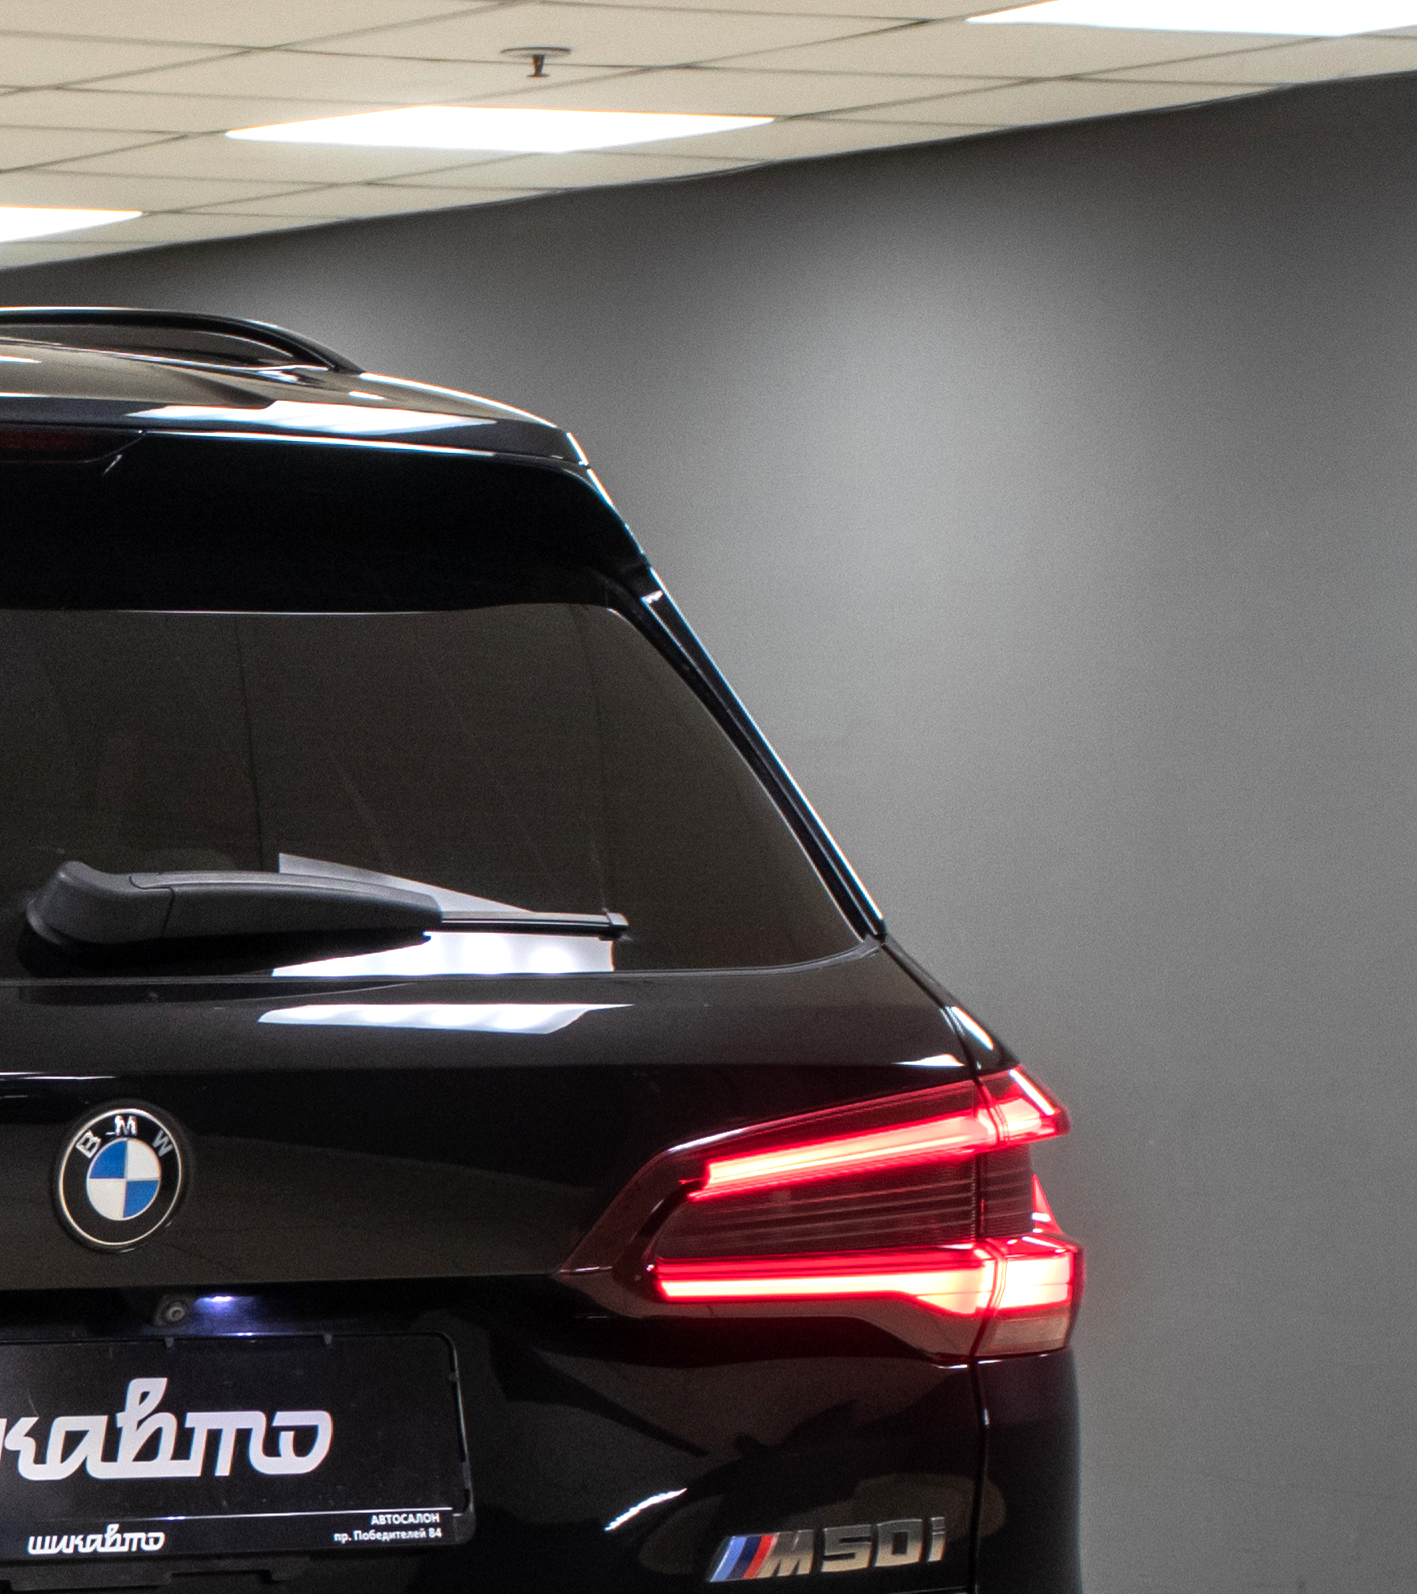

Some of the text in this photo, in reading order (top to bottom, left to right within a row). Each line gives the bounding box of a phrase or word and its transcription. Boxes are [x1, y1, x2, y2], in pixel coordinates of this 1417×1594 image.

[75, 1115, 174, 1158] BMW
[370, 1512, 441, 1526] АВТОСАЛОН
[27, 1523, 166, 1555] шикавто
[333, 1527, 442, 1544] пр. Победителей 84
[711, 1517, 945, 1582] M50i
